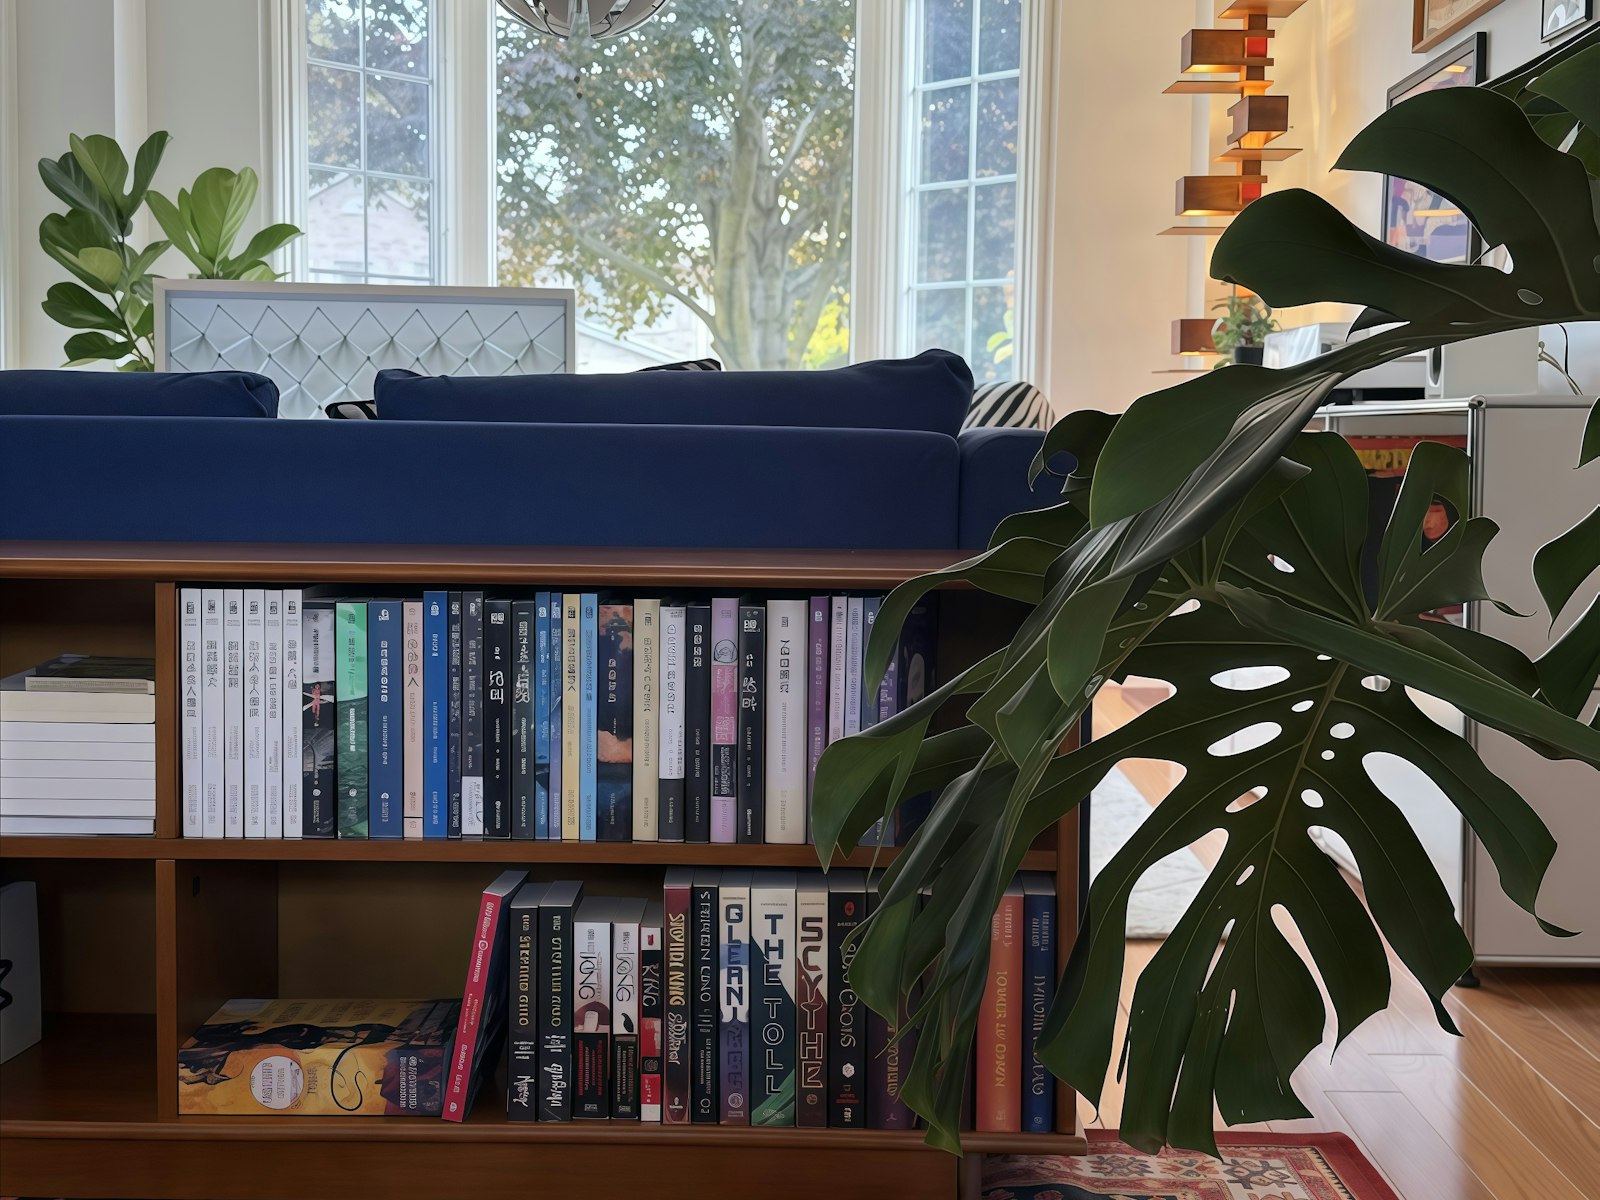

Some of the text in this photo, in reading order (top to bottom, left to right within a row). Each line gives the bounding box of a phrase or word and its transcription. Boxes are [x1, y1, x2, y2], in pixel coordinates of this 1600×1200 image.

[762, 913, 785, 1095] THE TOLL
[800, 916, 824, 1088] SCYTHE
